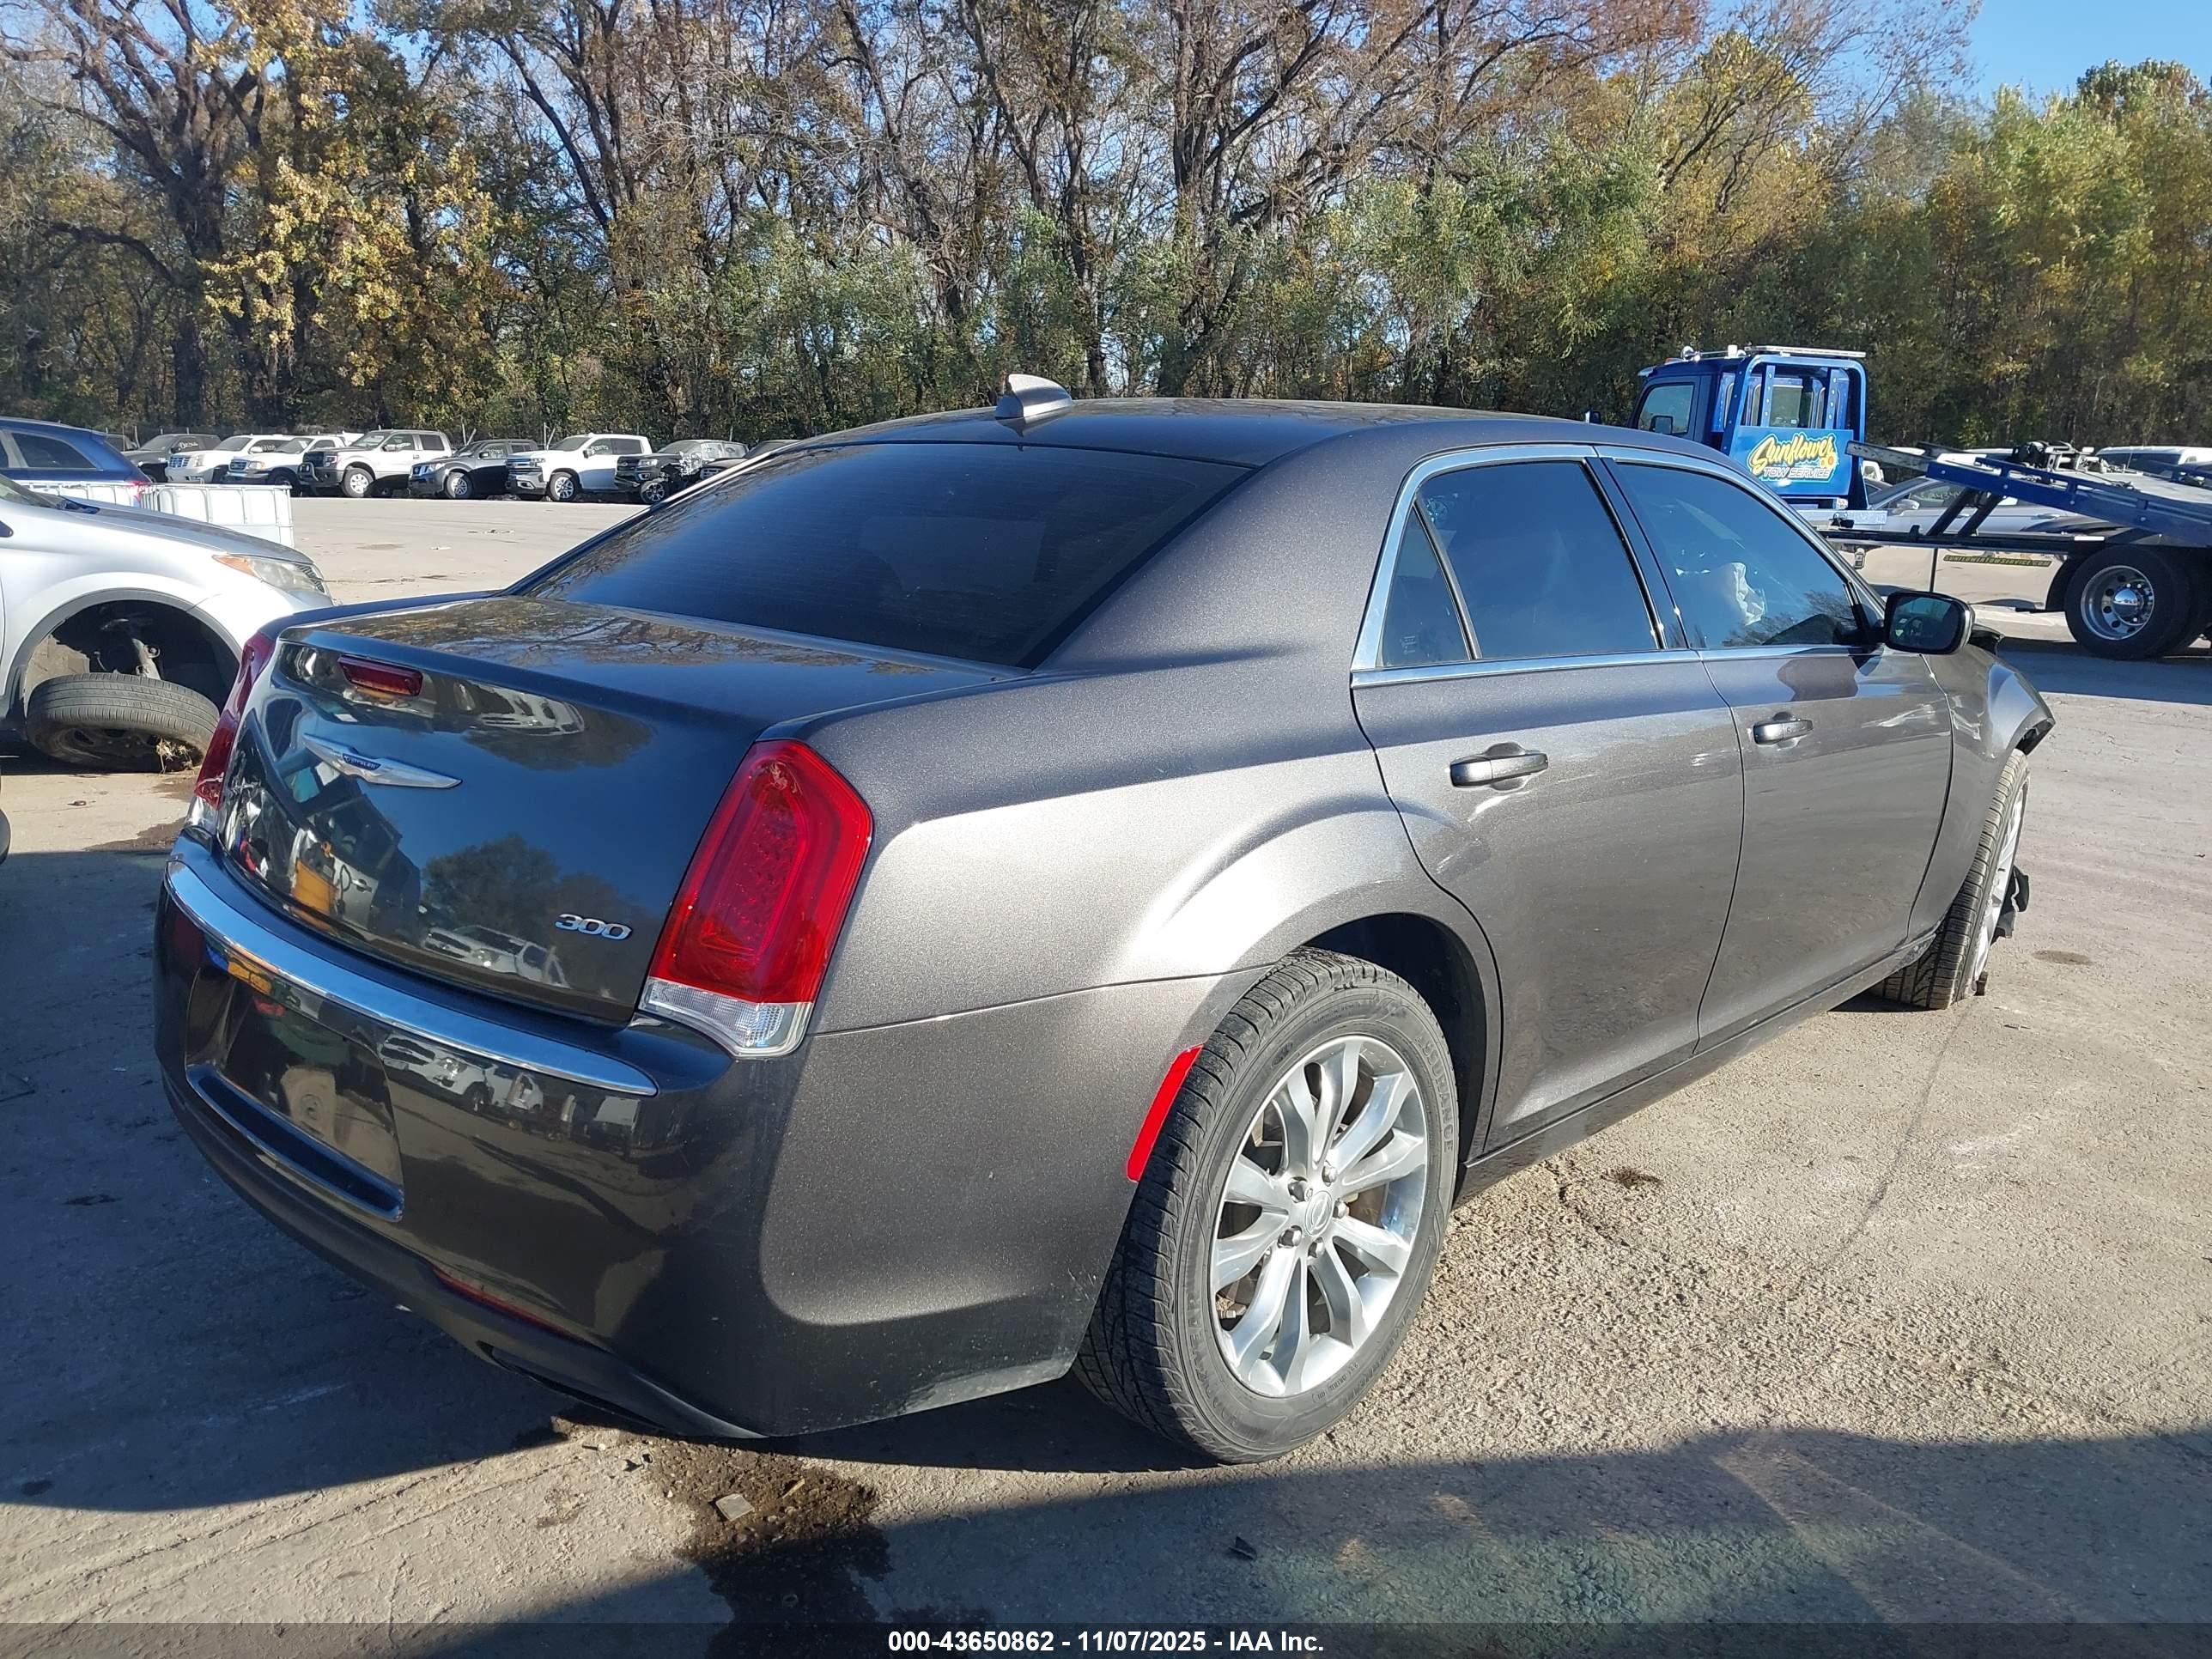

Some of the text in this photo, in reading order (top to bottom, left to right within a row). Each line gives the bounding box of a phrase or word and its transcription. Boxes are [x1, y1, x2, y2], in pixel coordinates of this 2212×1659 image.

[1749, 434, 1835, 475] Sunflower
[1762, 466, 1832, 479] TOW SERVICE
[555, 913, 632, 940] 300
